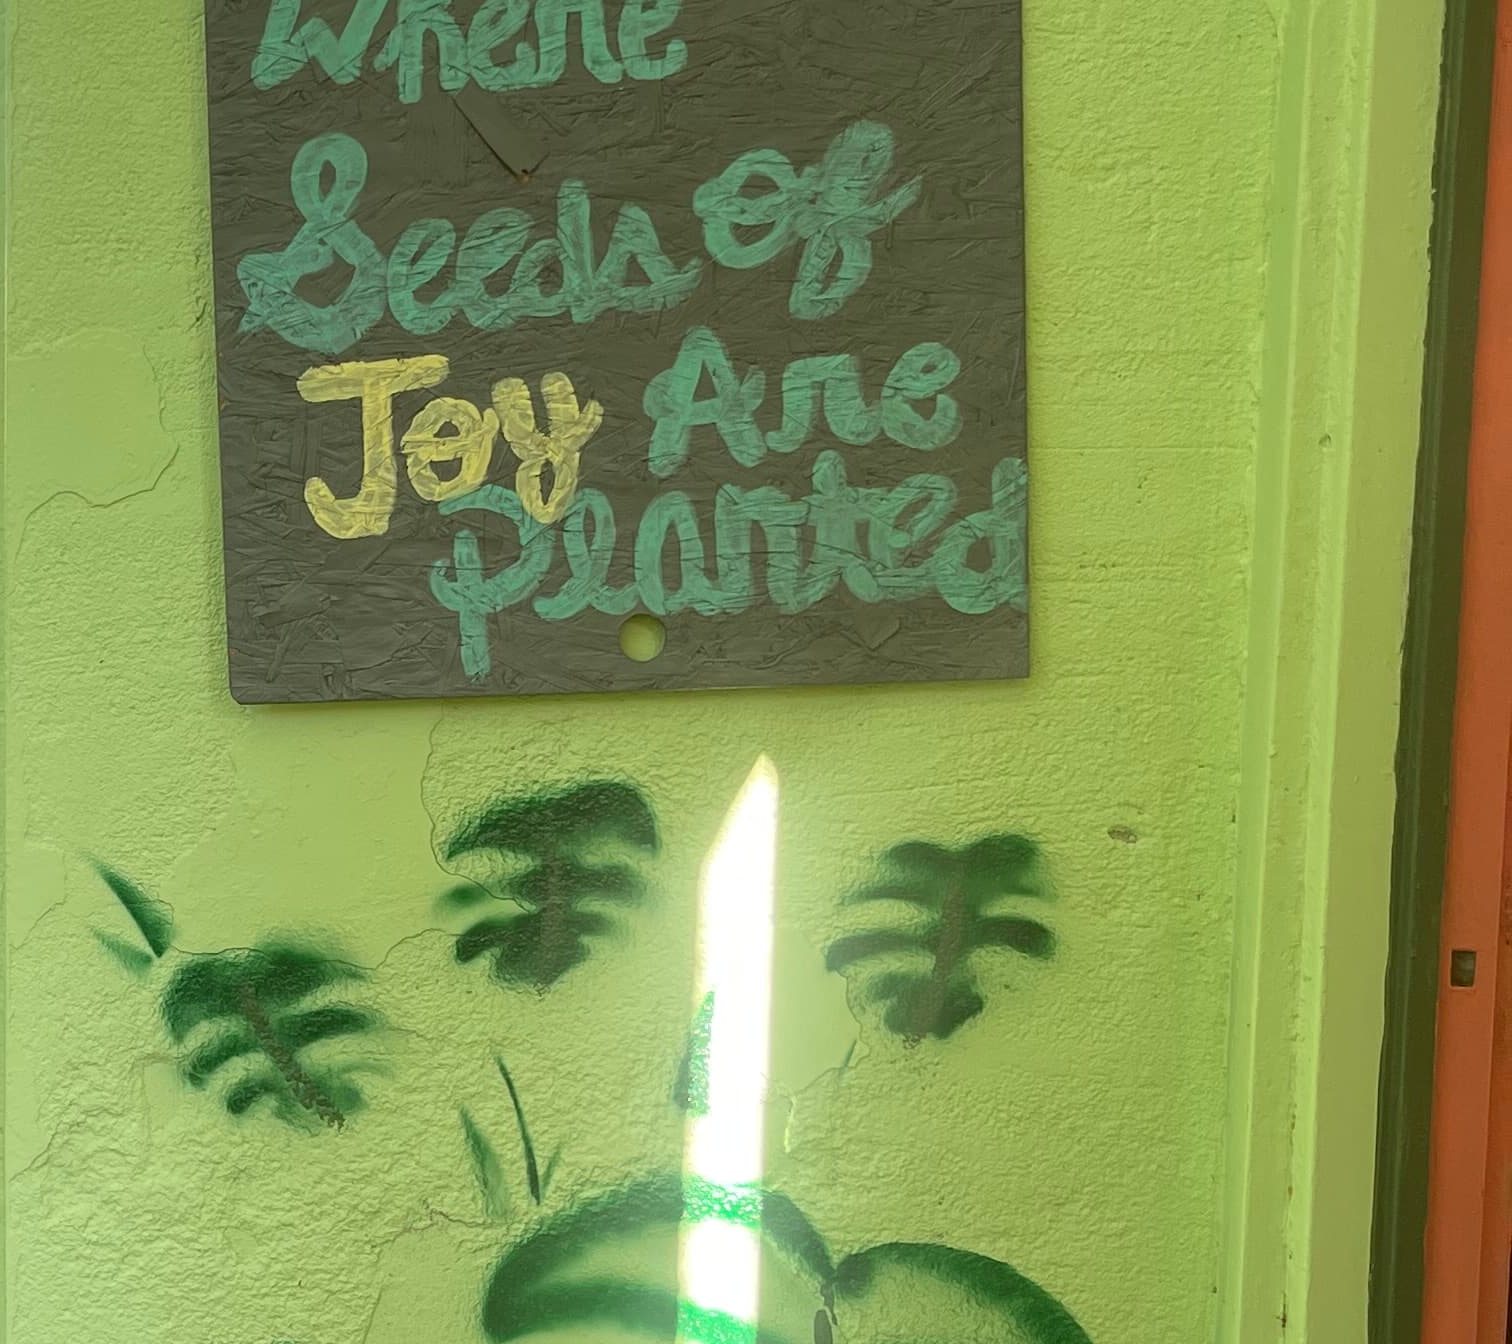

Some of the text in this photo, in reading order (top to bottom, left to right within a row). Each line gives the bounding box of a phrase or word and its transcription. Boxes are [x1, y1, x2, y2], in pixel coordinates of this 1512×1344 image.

[236, 120, 922, 353] Seeds Of
[298, 326, 964, 539] Joy Are
